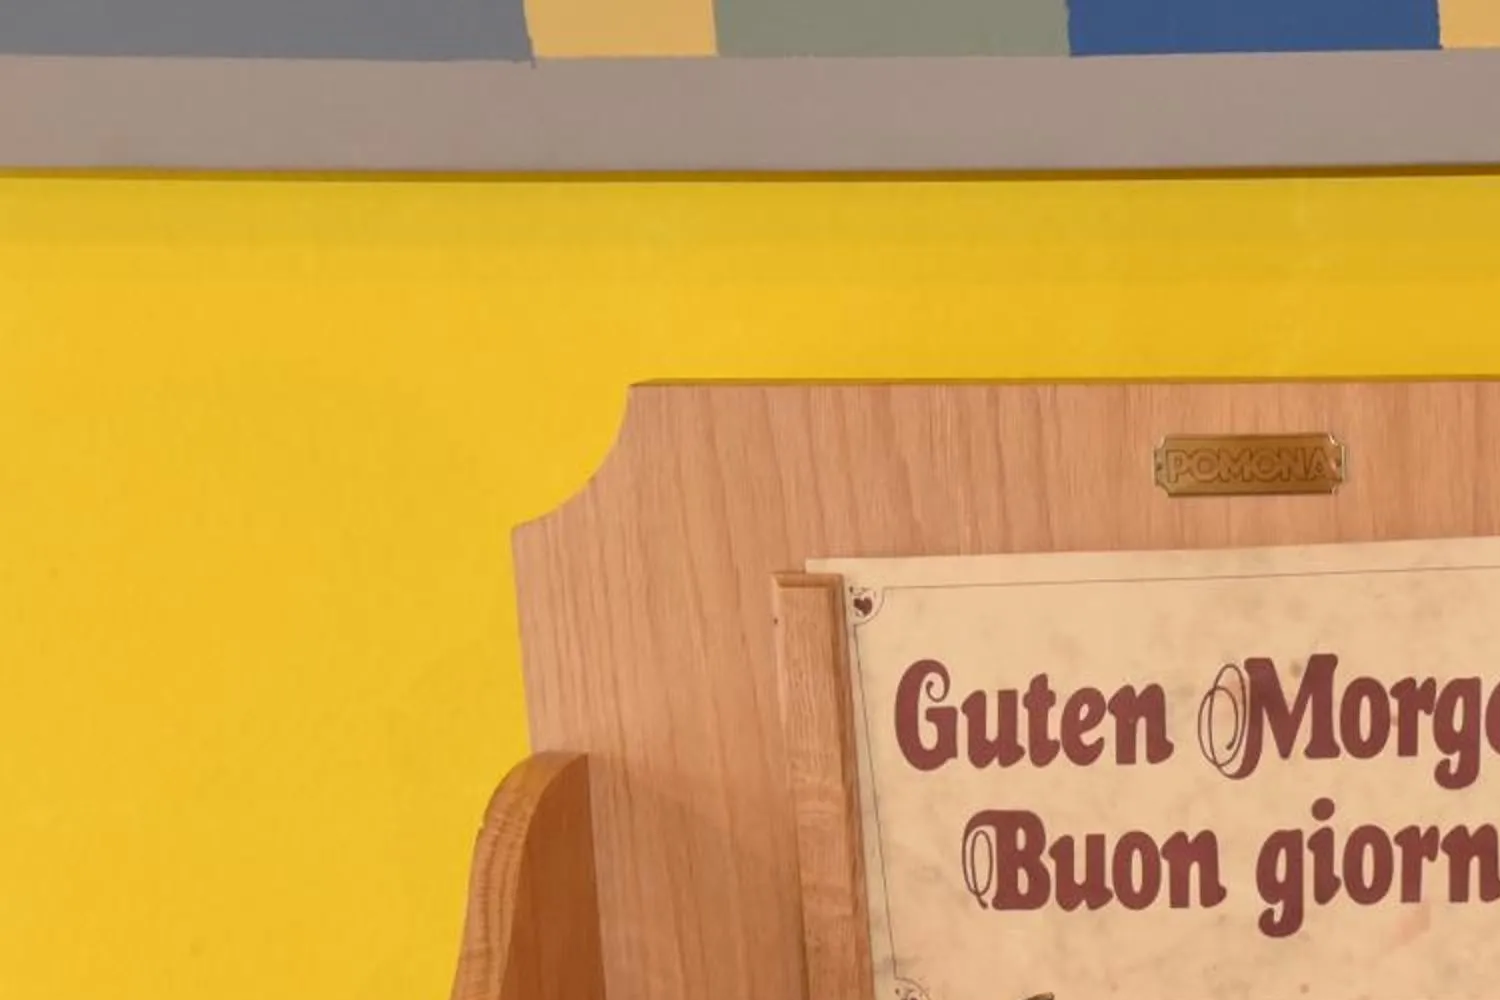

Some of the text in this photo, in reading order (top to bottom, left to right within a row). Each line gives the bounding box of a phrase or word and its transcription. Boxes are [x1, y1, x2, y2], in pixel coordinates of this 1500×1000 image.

[1165, 448, 1337, 483] POMONA
[895, 658, 1174, 771] Guten
[962, 809, 1227, 912] Buon
